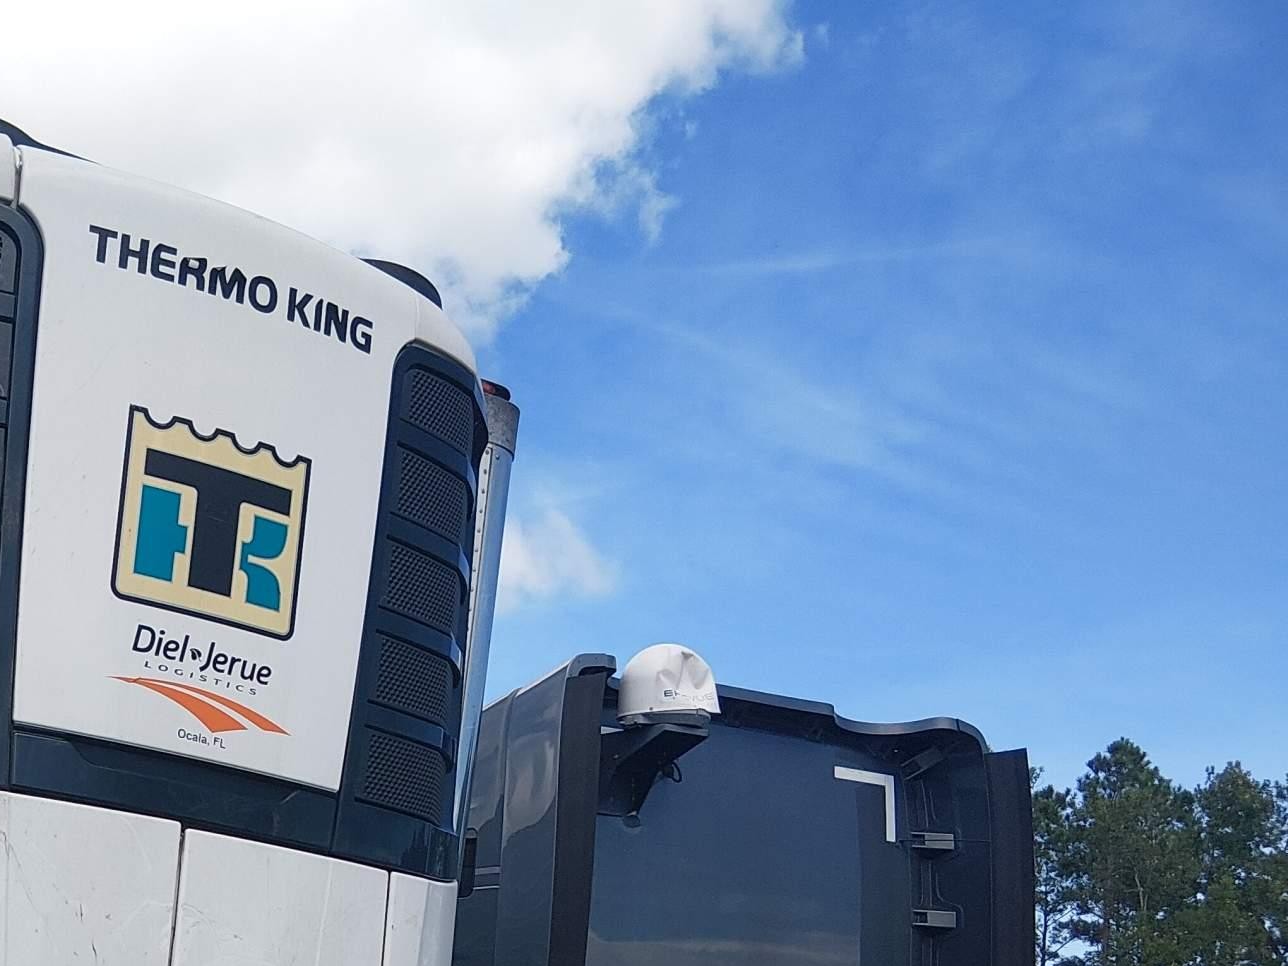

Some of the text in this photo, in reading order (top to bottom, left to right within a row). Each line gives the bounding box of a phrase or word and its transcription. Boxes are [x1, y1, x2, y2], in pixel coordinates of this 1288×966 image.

[88, 224, 374, 355] THERMO KING
[131, 624, 272, 686] Diel Jerue
[143, 660, 258, 696] LOGISTICS
[177, 728, 226, 749] Ocala, FL
